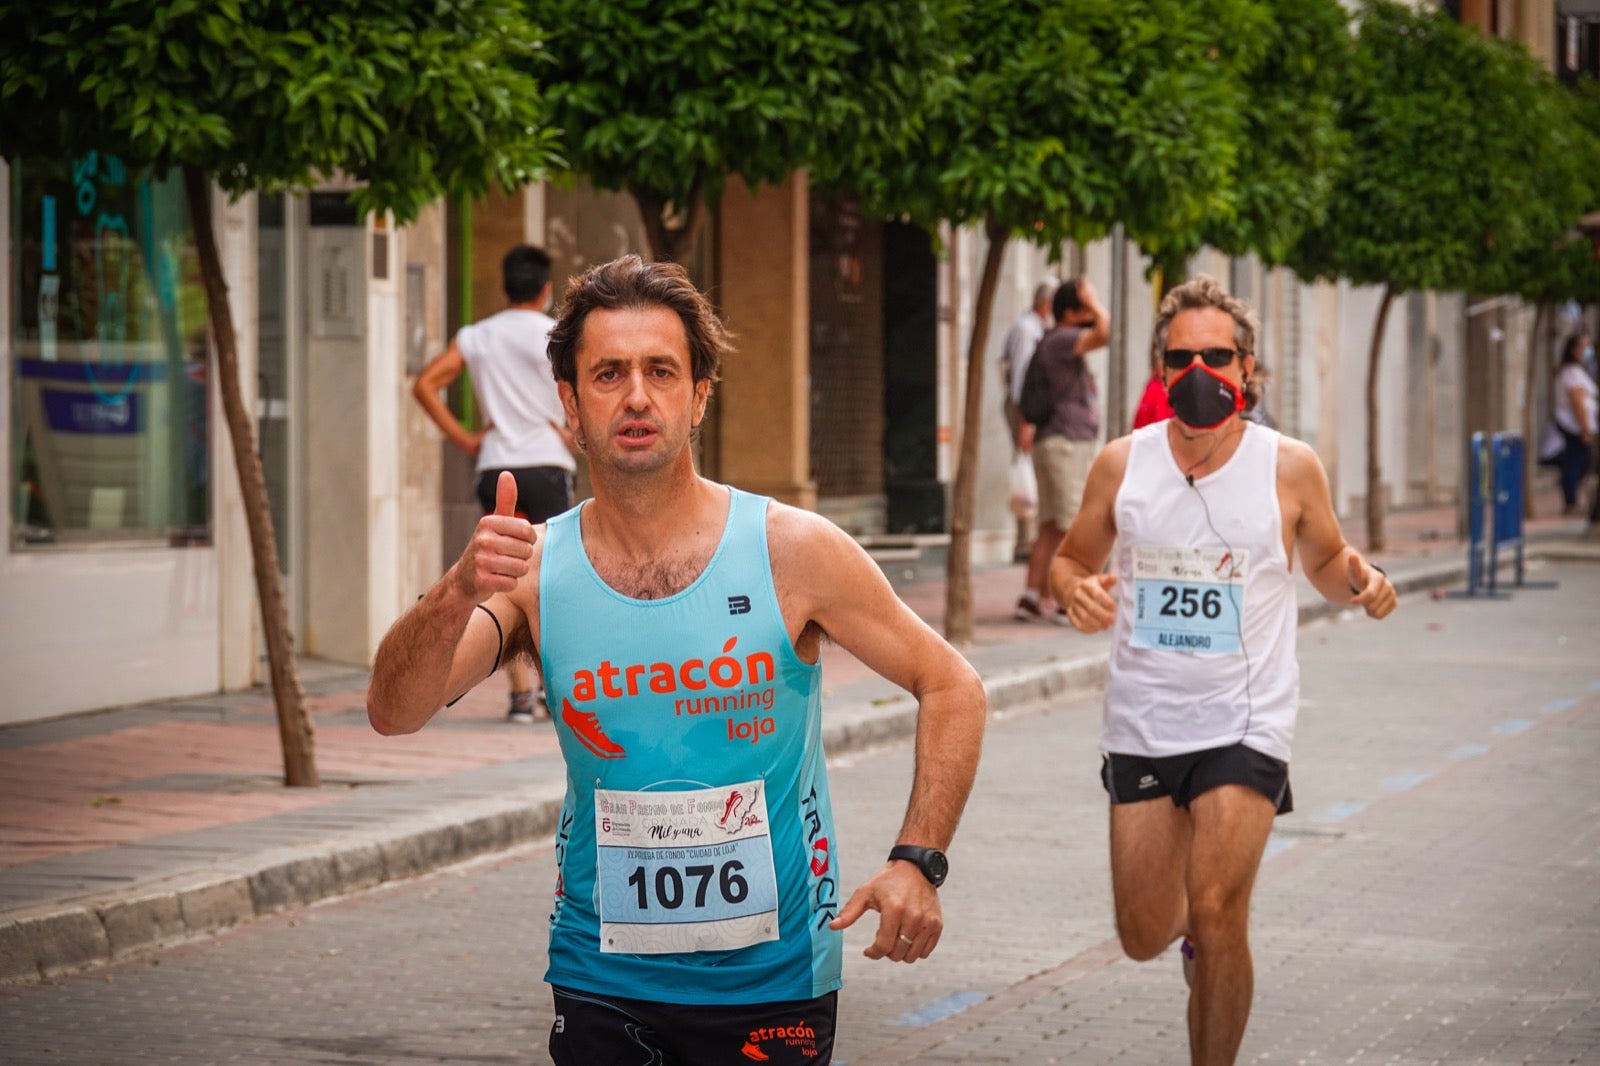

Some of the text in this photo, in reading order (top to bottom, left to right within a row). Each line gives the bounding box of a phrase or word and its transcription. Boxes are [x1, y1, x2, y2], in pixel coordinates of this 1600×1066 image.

[1159, 586, 1221, 619] 256
[1158, 632, 1211, 648] ALEJANDRO
[573, 636, 775, 701] atracón
[675, 687, 775, 716] running
[727, 715, 775, 744] loja
[628, 860, 749, 910] 1076
[749, 1020, 815, 1042] atracón
